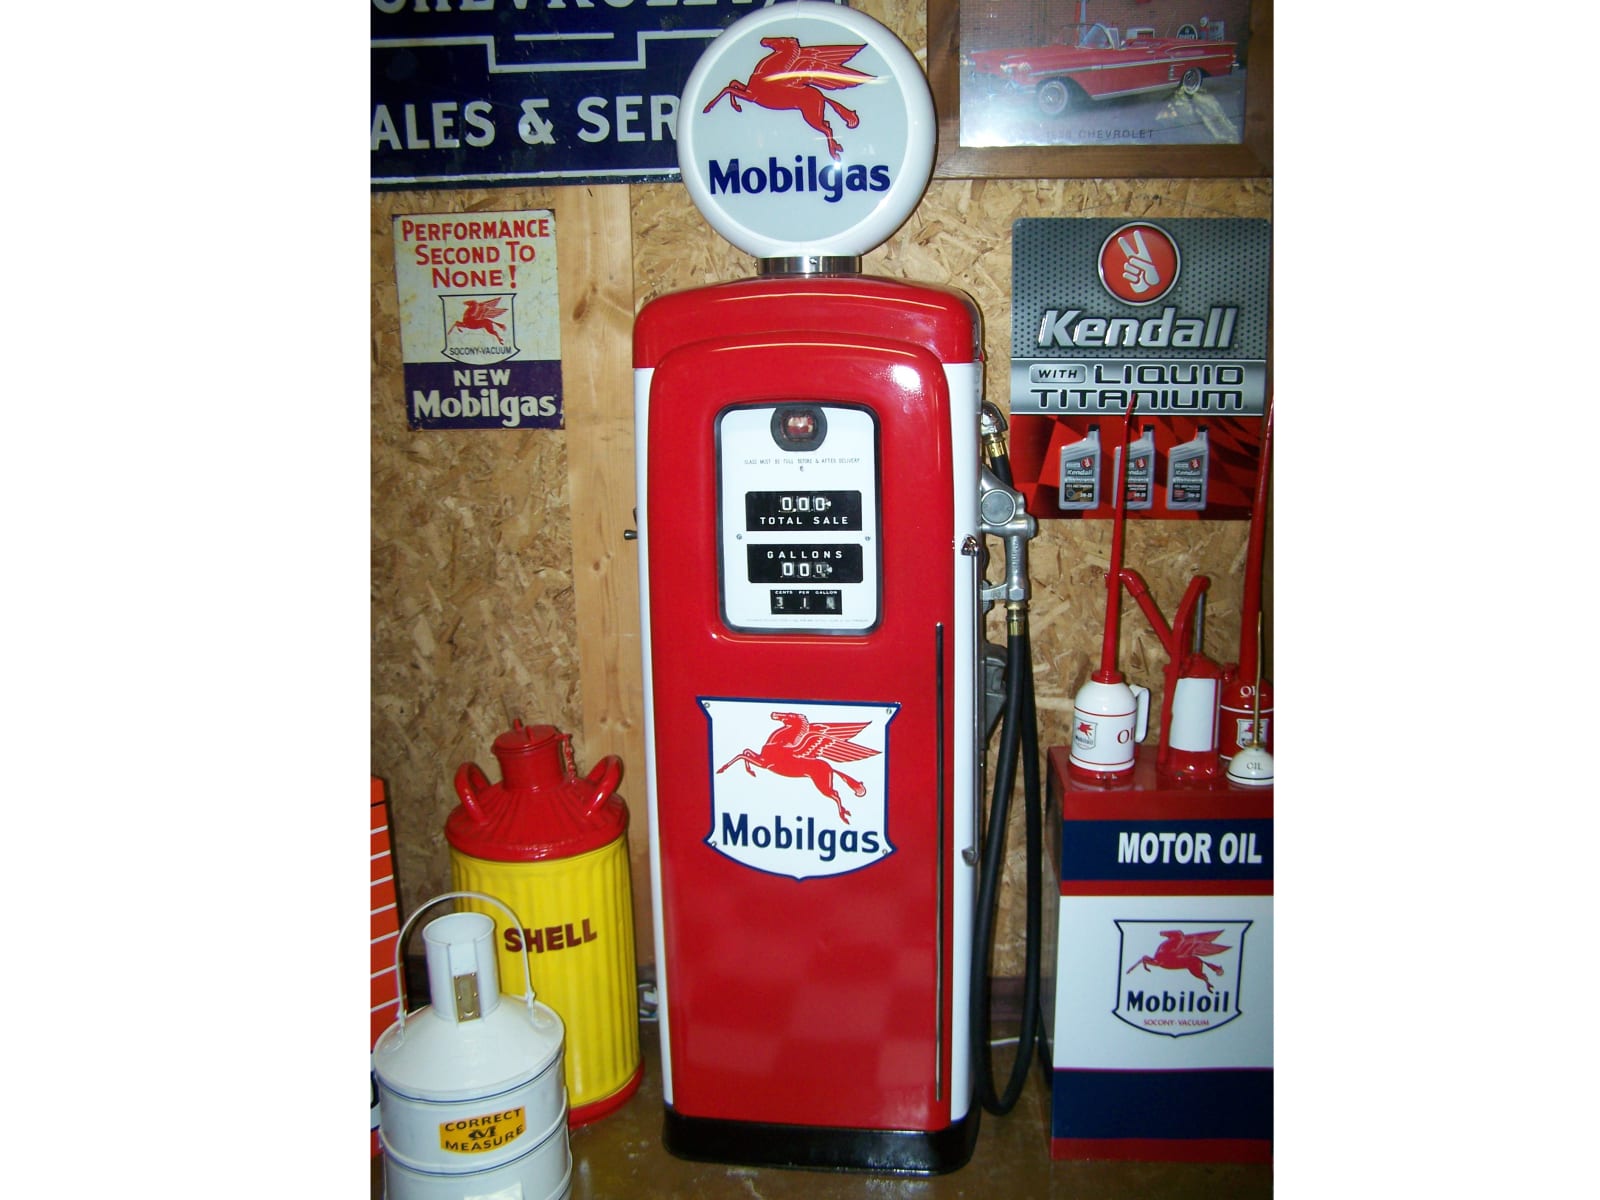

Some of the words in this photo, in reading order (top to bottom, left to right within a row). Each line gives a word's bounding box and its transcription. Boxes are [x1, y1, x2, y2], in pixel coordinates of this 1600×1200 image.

[518, 98, 557, 145] &
[1078, 128, 1154, 140] CHEVROLET
[708, 154, 891, 203] Mobilgas
[401, 219, 550, 242] PERFORMANCE
[415, 244, 500, 266] SECOND
[505, 241, 536, 263] TO
[1037, 306, 1239, 349] Kendall
[449, 346, 513, 356] SOCONY-VACUUM
[453, 368, 511, 387] NEW
[1038, 369, 1078, 379] WITH
[1094, 365, 1244, 385] LIQUID
[412, 388, 557, 427] Mobilgas
[1030, 389, 1243, 409] TITANIUM
[760, 516, 803, 525] TOTAL
[813, 516, 849, 525] SALE
[767, 550, 843, 559] GALLONS
[1246, 762, 1263, 771] OIL
[722, 812, 880, 862] Mobilgas
[1117, 831, 1212, 865] MOTOR
[1218, 831, 1263, 865] OIL
[504, 918, 597, 953] SHELL
[1126, 990, 1229, 1012] Mobiloil
[445, 1109, 521, 1132] CORRECT
[445, 1125, 525, 1151] MEASURE
